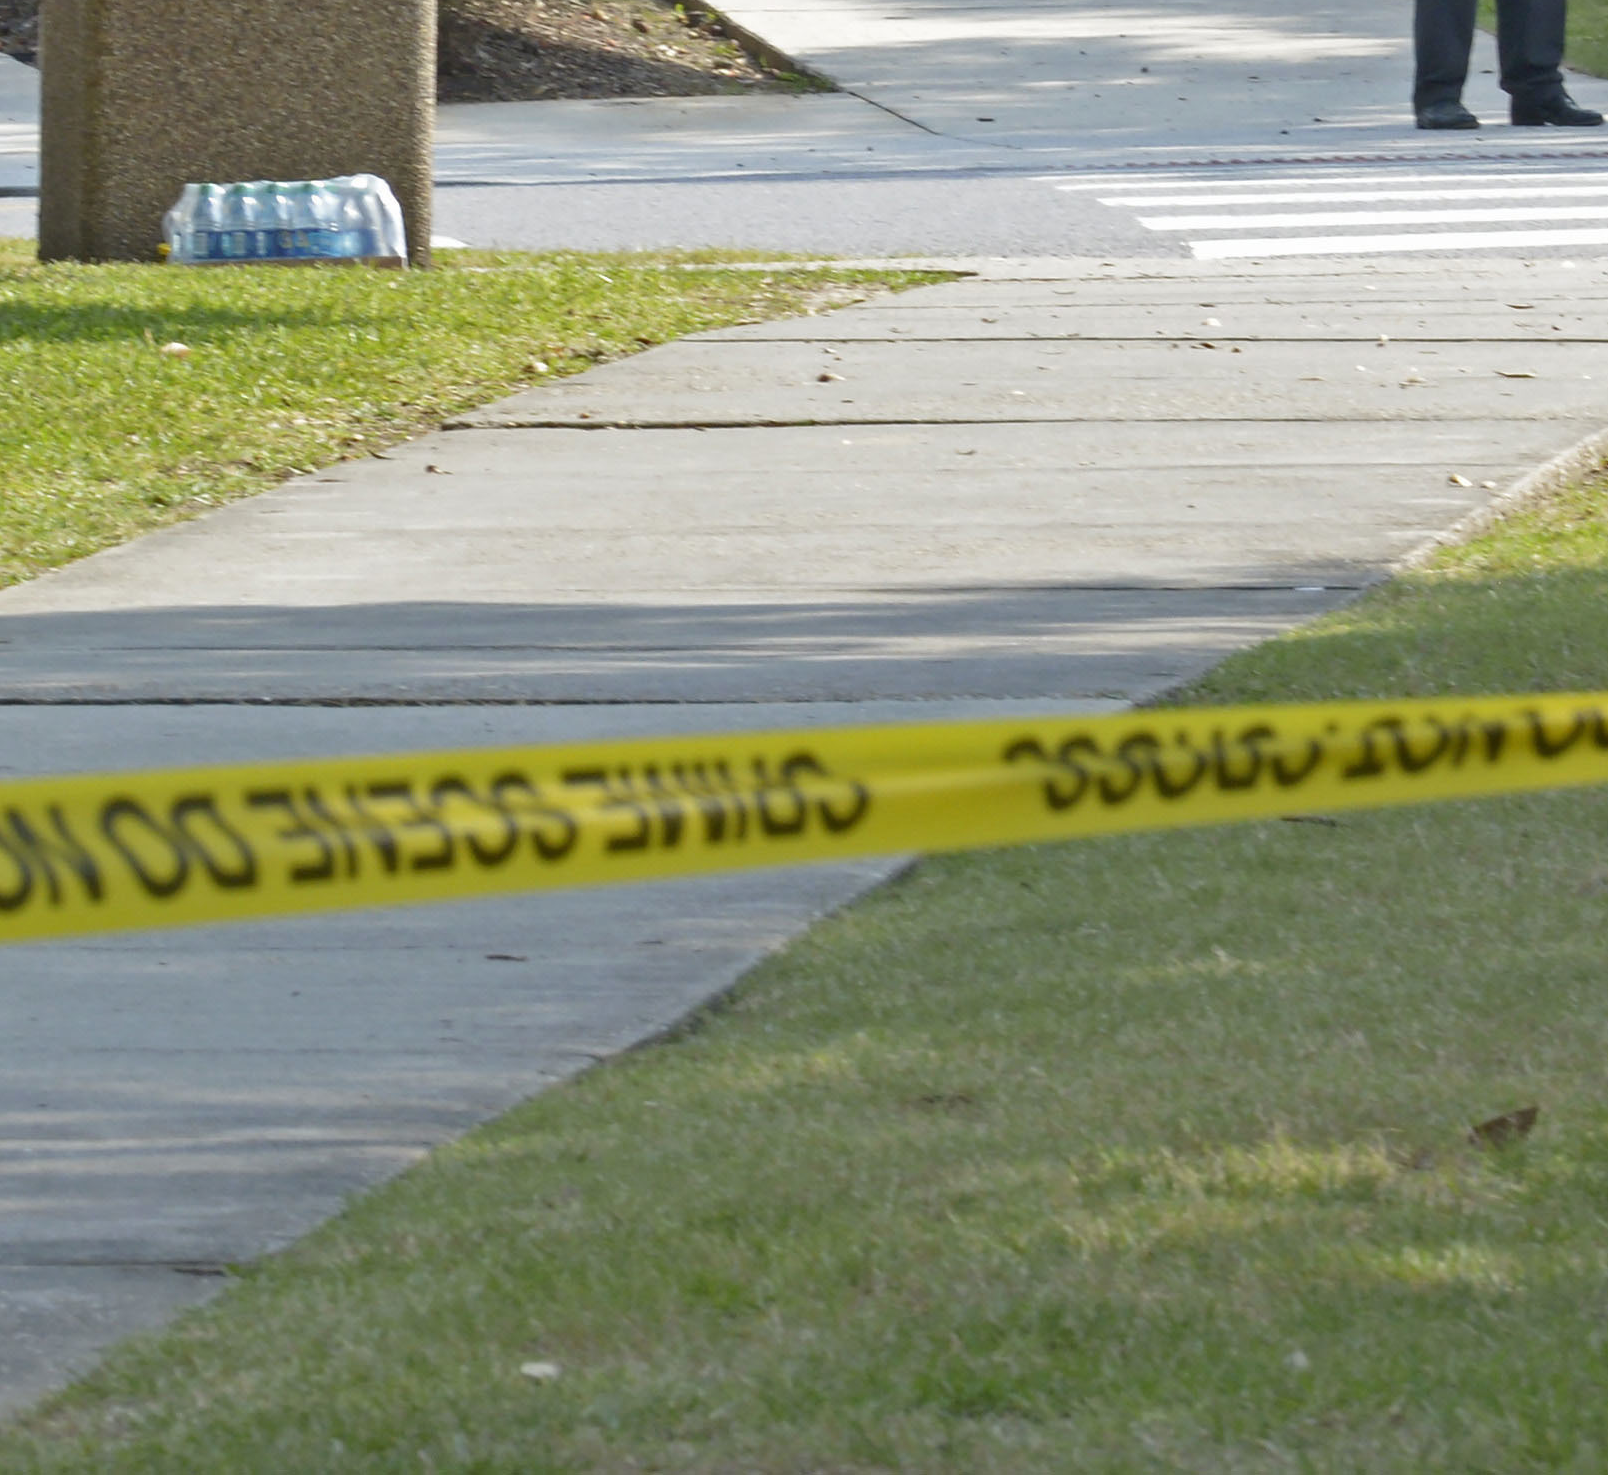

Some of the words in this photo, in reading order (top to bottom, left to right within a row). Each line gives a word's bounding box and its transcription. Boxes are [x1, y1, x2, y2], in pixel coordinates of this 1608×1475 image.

[98, 789, 260, 899] DO
[243, 771, 580, 884] SCENE
[559, 752, 872, 854] CRIME
